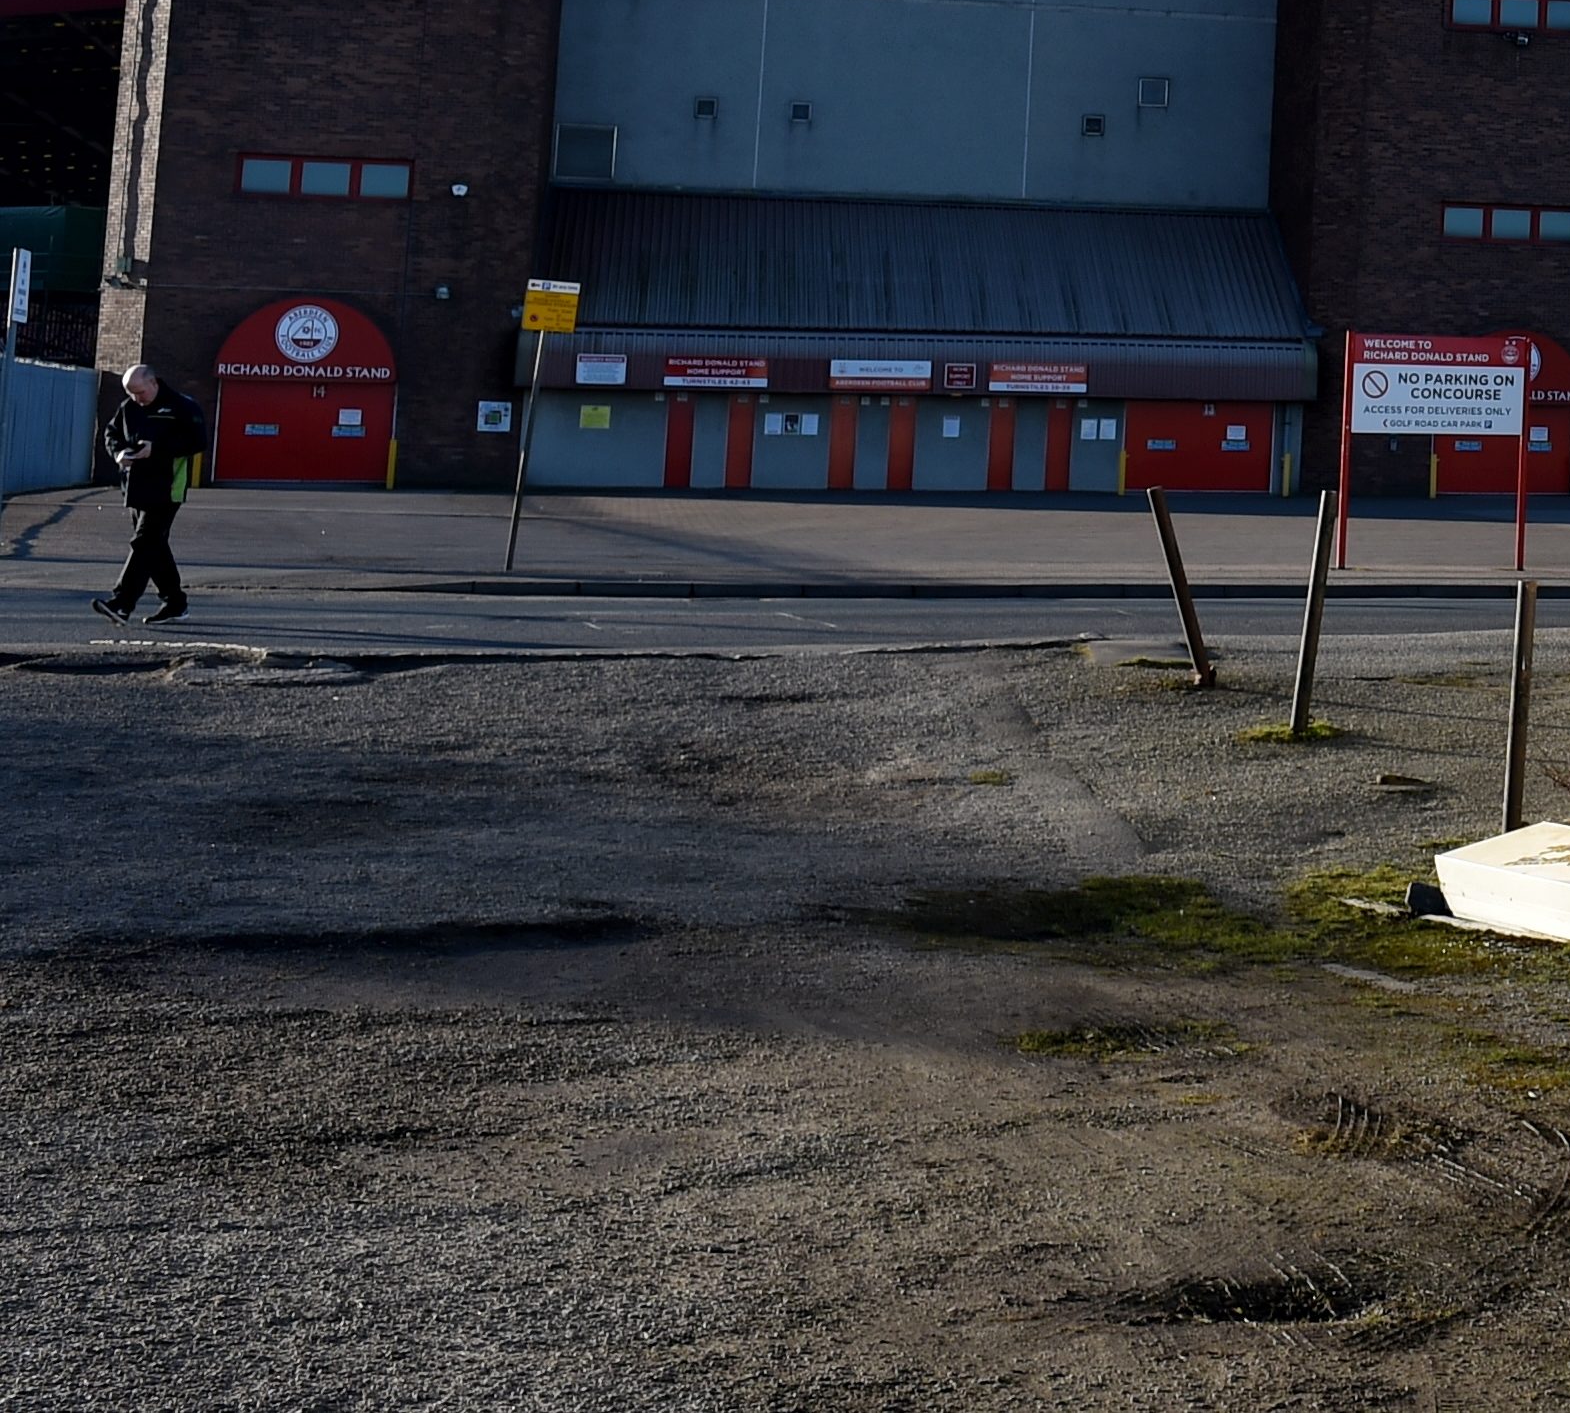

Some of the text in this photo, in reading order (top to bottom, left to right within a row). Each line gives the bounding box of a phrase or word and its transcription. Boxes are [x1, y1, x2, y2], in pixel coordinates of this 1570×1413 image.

[288, 309, 329, 323] ABERDEEN
[1364, 338, 1432, 349] WELCOME TO
[1363, 350, 1409, 361] RICHARD
[1411, 351, 1454, 362] DONALD
[1455, 353, 1489, 363] STAND
[668, 358, 766, 368] RICHARD DONALD STAND
[993, 364, 1026, 372] RICHARD
[1060, 365, 1085, 373] STAND
[217, 363, 391, 379] RICHARD DONALD STAND
[710, 368, 746, 376] SUPPORT
[1033, 374, 1067, 382] SUPPORT
[1398, 372, 1515, 387] NO PARKING ON
[312, 384, 326, 398] 14
[1410, 387, 1502, 401] CONCOURSE
[1363, 405, 1512, 416] ACCESS FOR DELIVERIES ONLY
[1389, 419, 1413, 428] GOLF
[1414, 419, 1438, 428] ROAD
[1440, 420, 1458, 428] CAR
[1459, 420, 1482, 429] PARK
